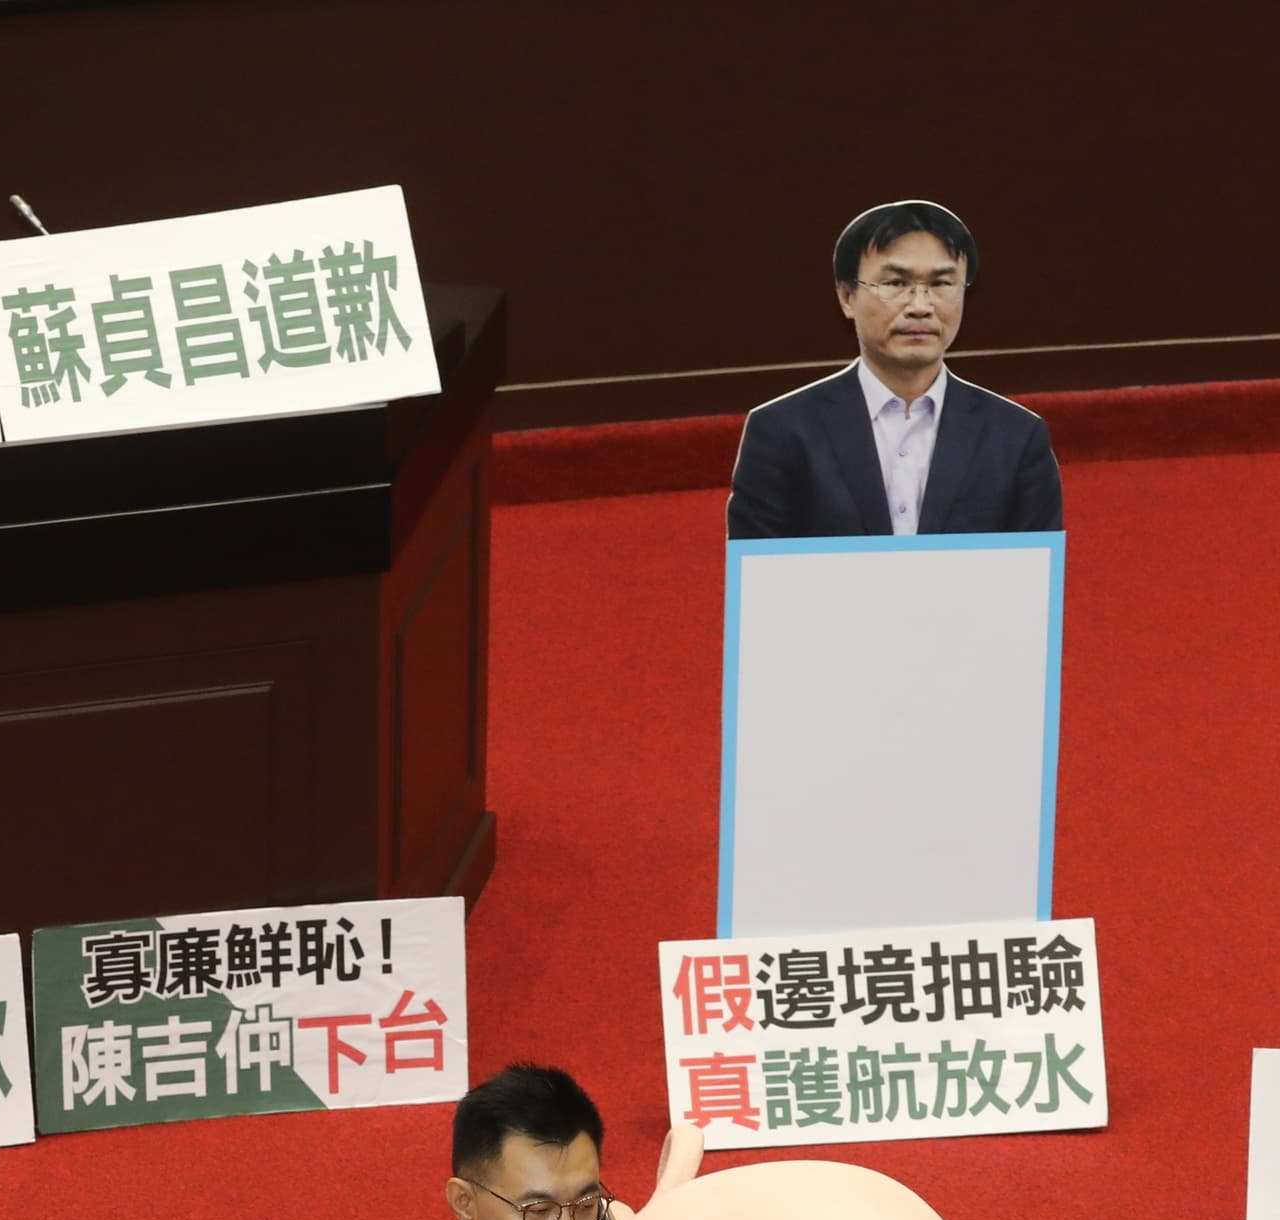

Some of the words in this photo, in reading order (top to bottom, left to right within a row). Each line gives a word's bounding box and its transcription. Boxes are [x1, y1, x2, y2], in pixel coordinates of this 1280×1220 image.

[2, 240, 412, 407] 蘇貞昌道歉
[673, 934, 1086, 1036] 假邊境抽驗
[61, 990, 447, 1111] 陳吉仲下台
[681, 1033, 1093, 1132] 真護航放水
